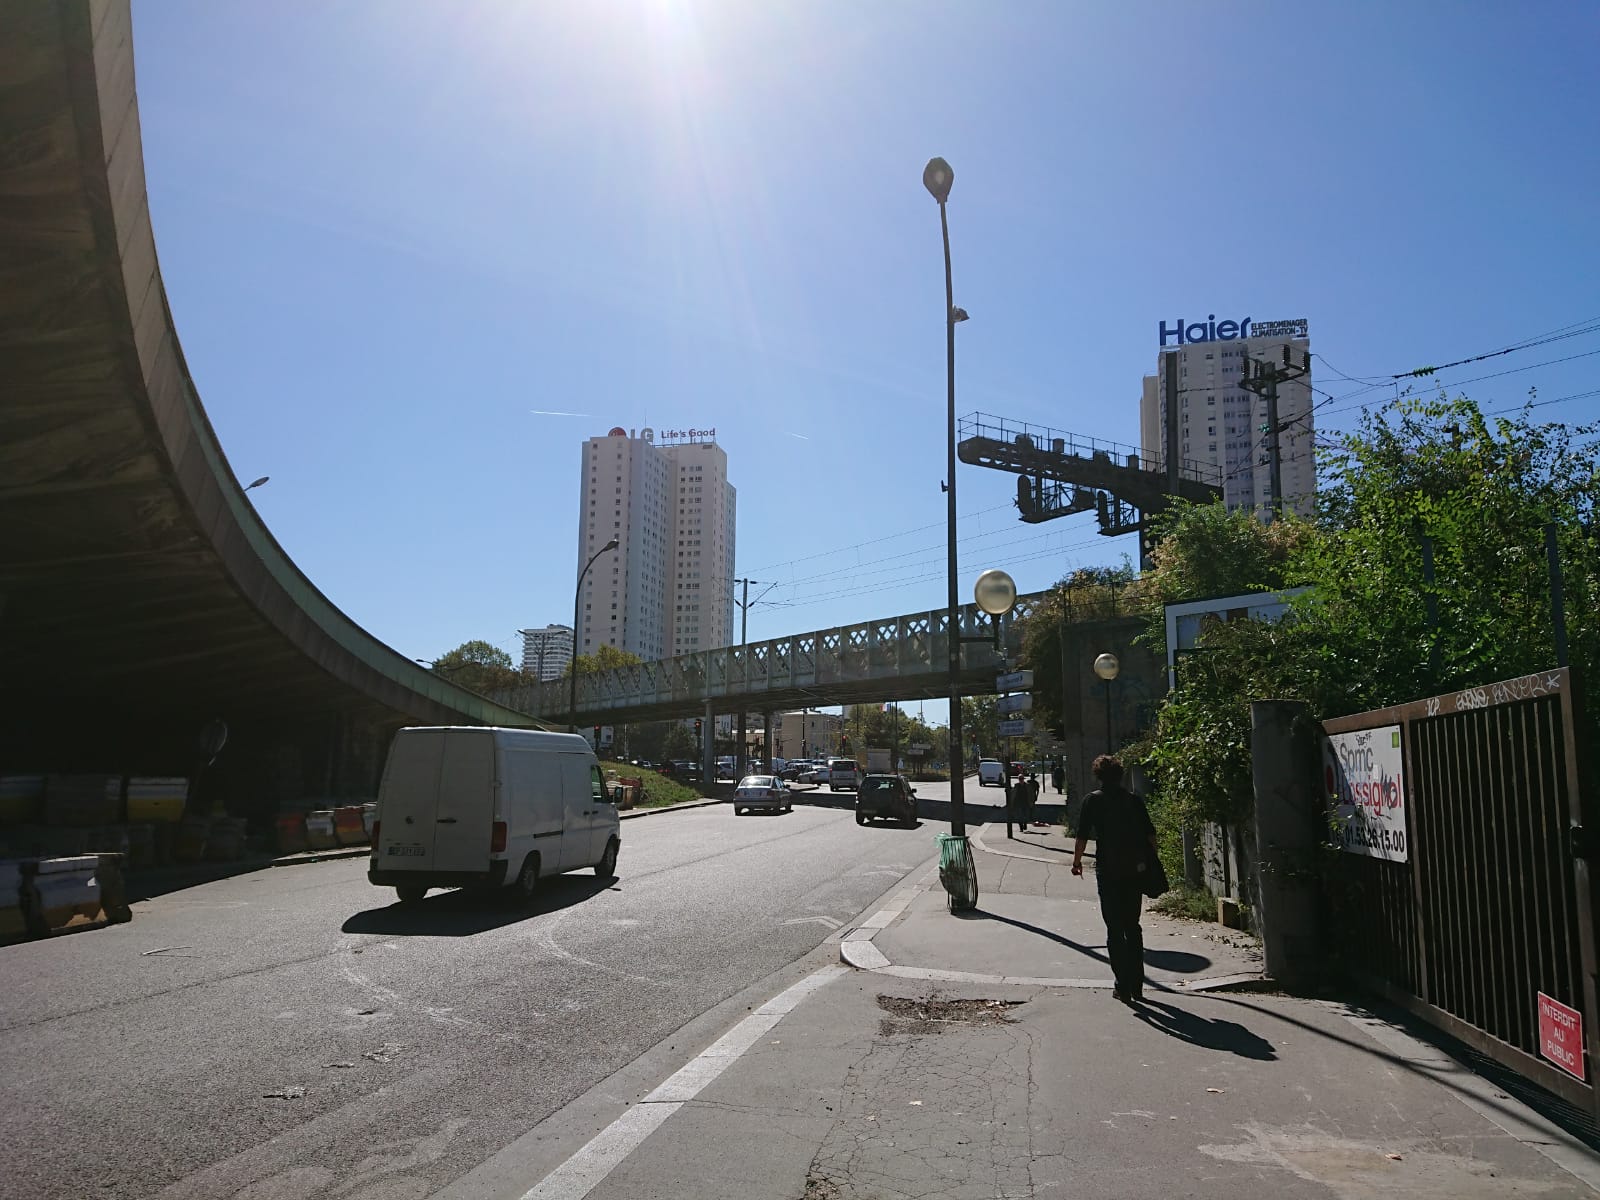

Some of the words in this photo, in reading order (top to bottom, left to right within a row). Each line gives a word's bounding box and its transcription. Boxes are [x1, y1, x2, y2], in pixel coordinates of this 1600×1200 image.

[1159, 314, 1251, 346] Haier
[1251, 327, 1295, 337] CLIMATISATION
[1299, 326, 1308, 334] TV
[661, 429, 686, 439] Life's
[688, 428, 716, 438] Good
[1542, 1002, 1576, 1031] INTERDIT
[1553, 1026, 1564, 1043] AU
[1547, 1039, 1575, 1067] PUBLIC
